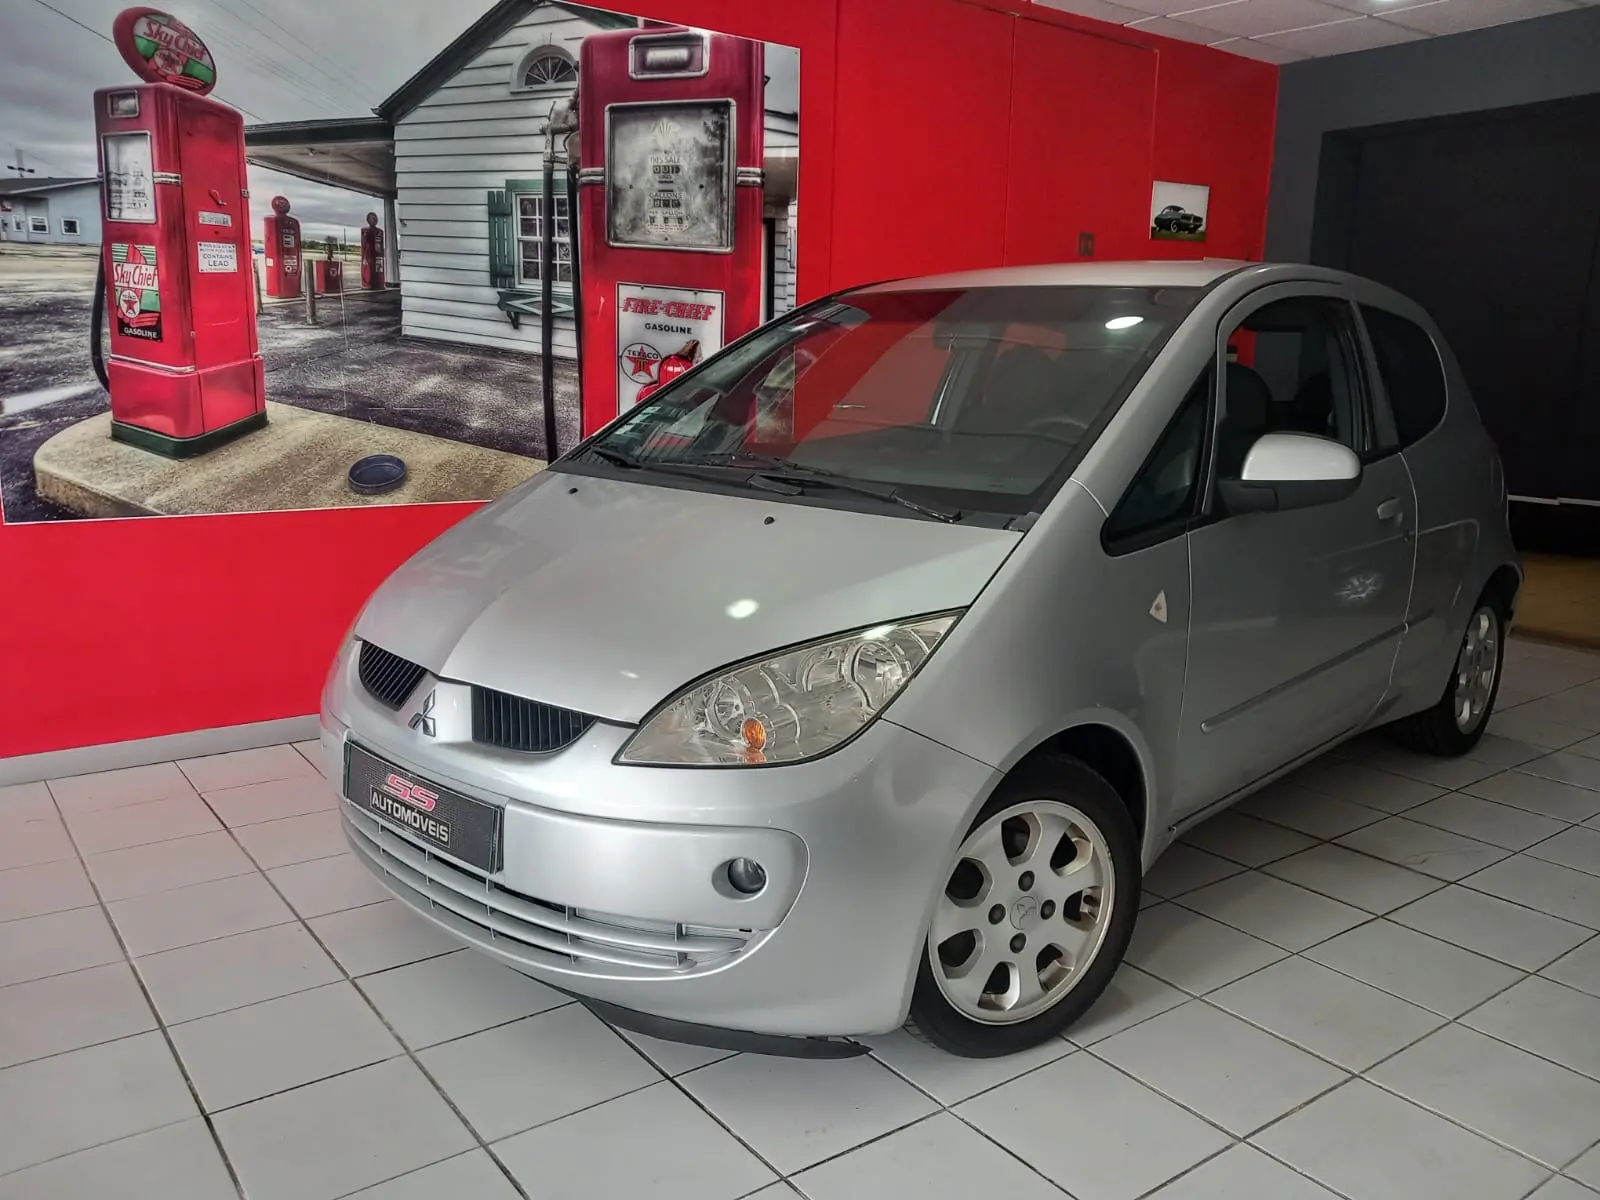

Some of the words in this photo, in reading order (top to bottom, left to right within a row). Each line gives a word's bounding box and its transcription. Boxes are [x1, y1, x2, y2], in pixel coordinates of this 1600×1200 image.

[143, 20, 174, 48] Sky
[115, 263, 132, 287] Sky
[132, 265, 158, 288] Chief
[622, 297, 716, 321] FIRE-CHIEF
[123, 327, 158, 339] GASOLINE
[644, 322, 692, 335] GASOLINE
[627, 349, 659, 360] TEXACO
[384, 773, 439, 812] SS
[372, 791, 449, 842] AUTOMÓVEIS
